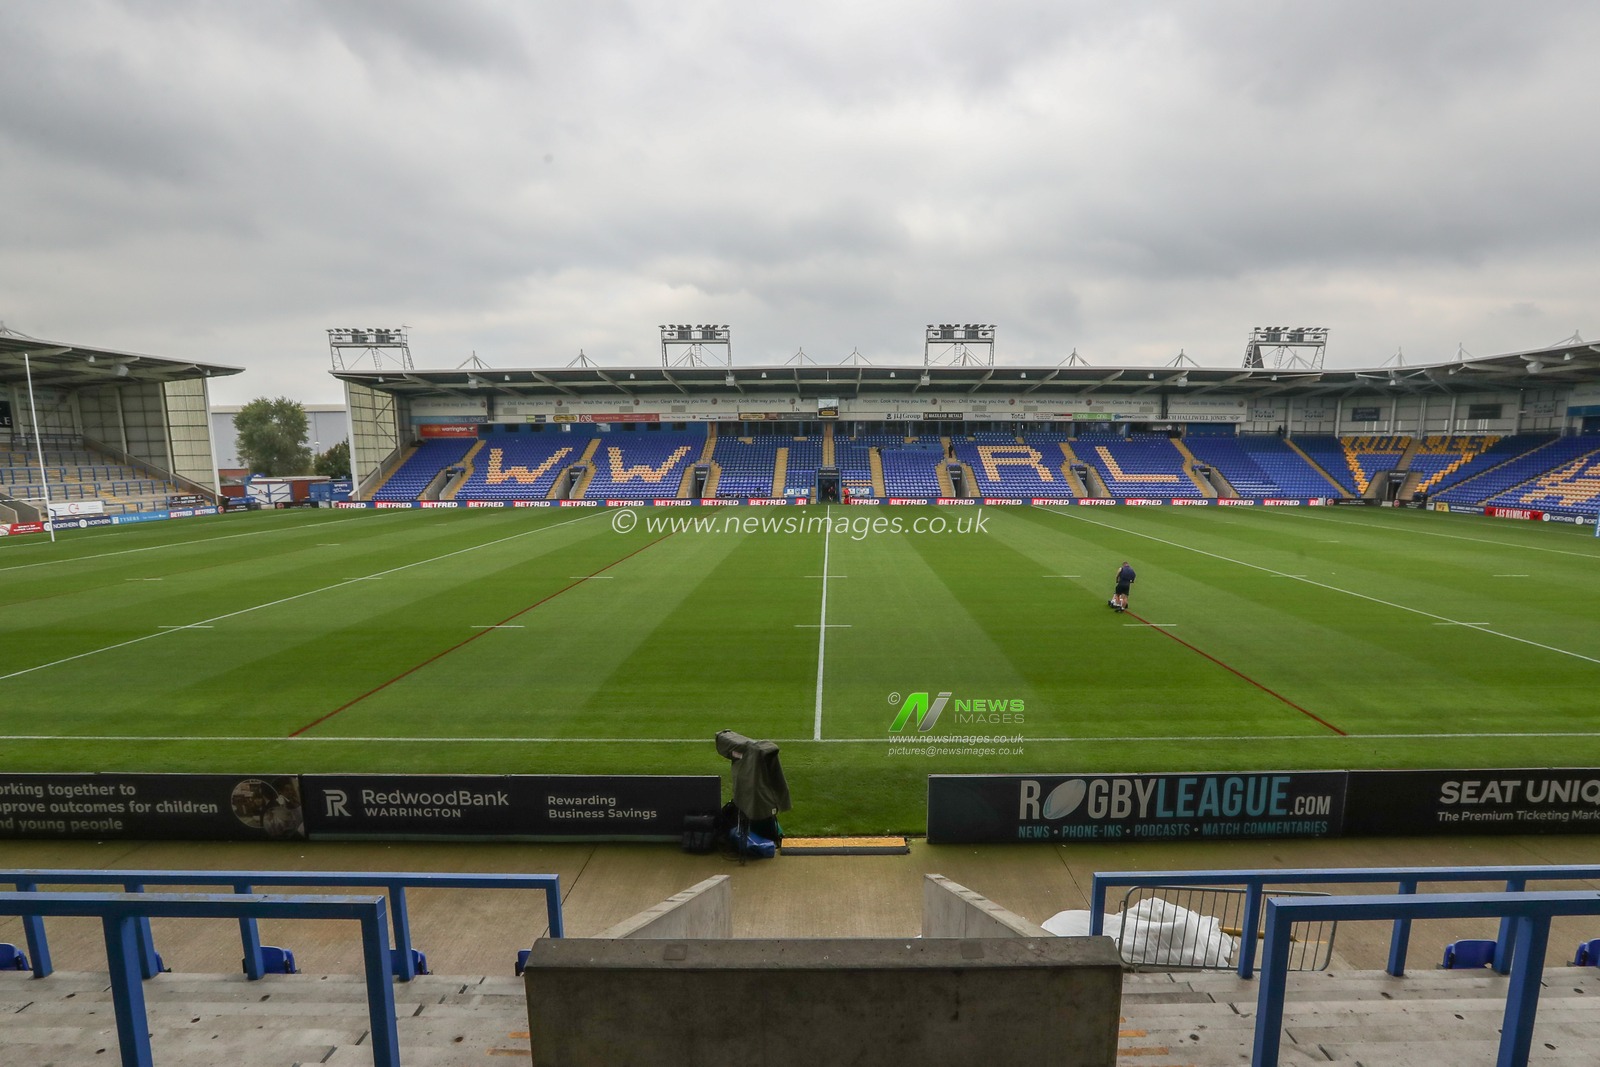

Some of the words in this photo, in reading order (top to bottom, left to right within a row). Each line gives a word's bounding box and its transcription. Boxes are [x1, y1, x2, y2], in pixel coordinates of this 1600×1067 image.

[48, 785, 116, 798] together
[120, 785, 136, 796] to
[362, 789, 509, 806] RedwoodBank
[1440, 781, 1521, 804] SEAT
[0, 803, 46, 814] prove
[50, 802, 125, 812] outcomes
[129, 801, 151, 812] for
[156, 801, 218, 813] children
[548, 795, 616, 807] Rewarding
[364, 807, 461, 818] WARRINGTON
[549, 809, 604, 818] Business
[608, 808, 657, 820] Savings
[1438, 812, 1458, 821] The
[1462, 811, 1513, 821] Premium
[1517, 811, 1569, 822] Ticketing
[19, 820, 65, 832] young
[71, 818, 123, 832] people
[1018, 825, 1049, 838] NEWS
[1062, 824, 1121, 837] PHONE-INS
[1134, 824, 1190, 836] PODCASTS
[1202, 822, 1240, 835] MATCH
[1243, 821, 1328, 835] COMMENTARIES
